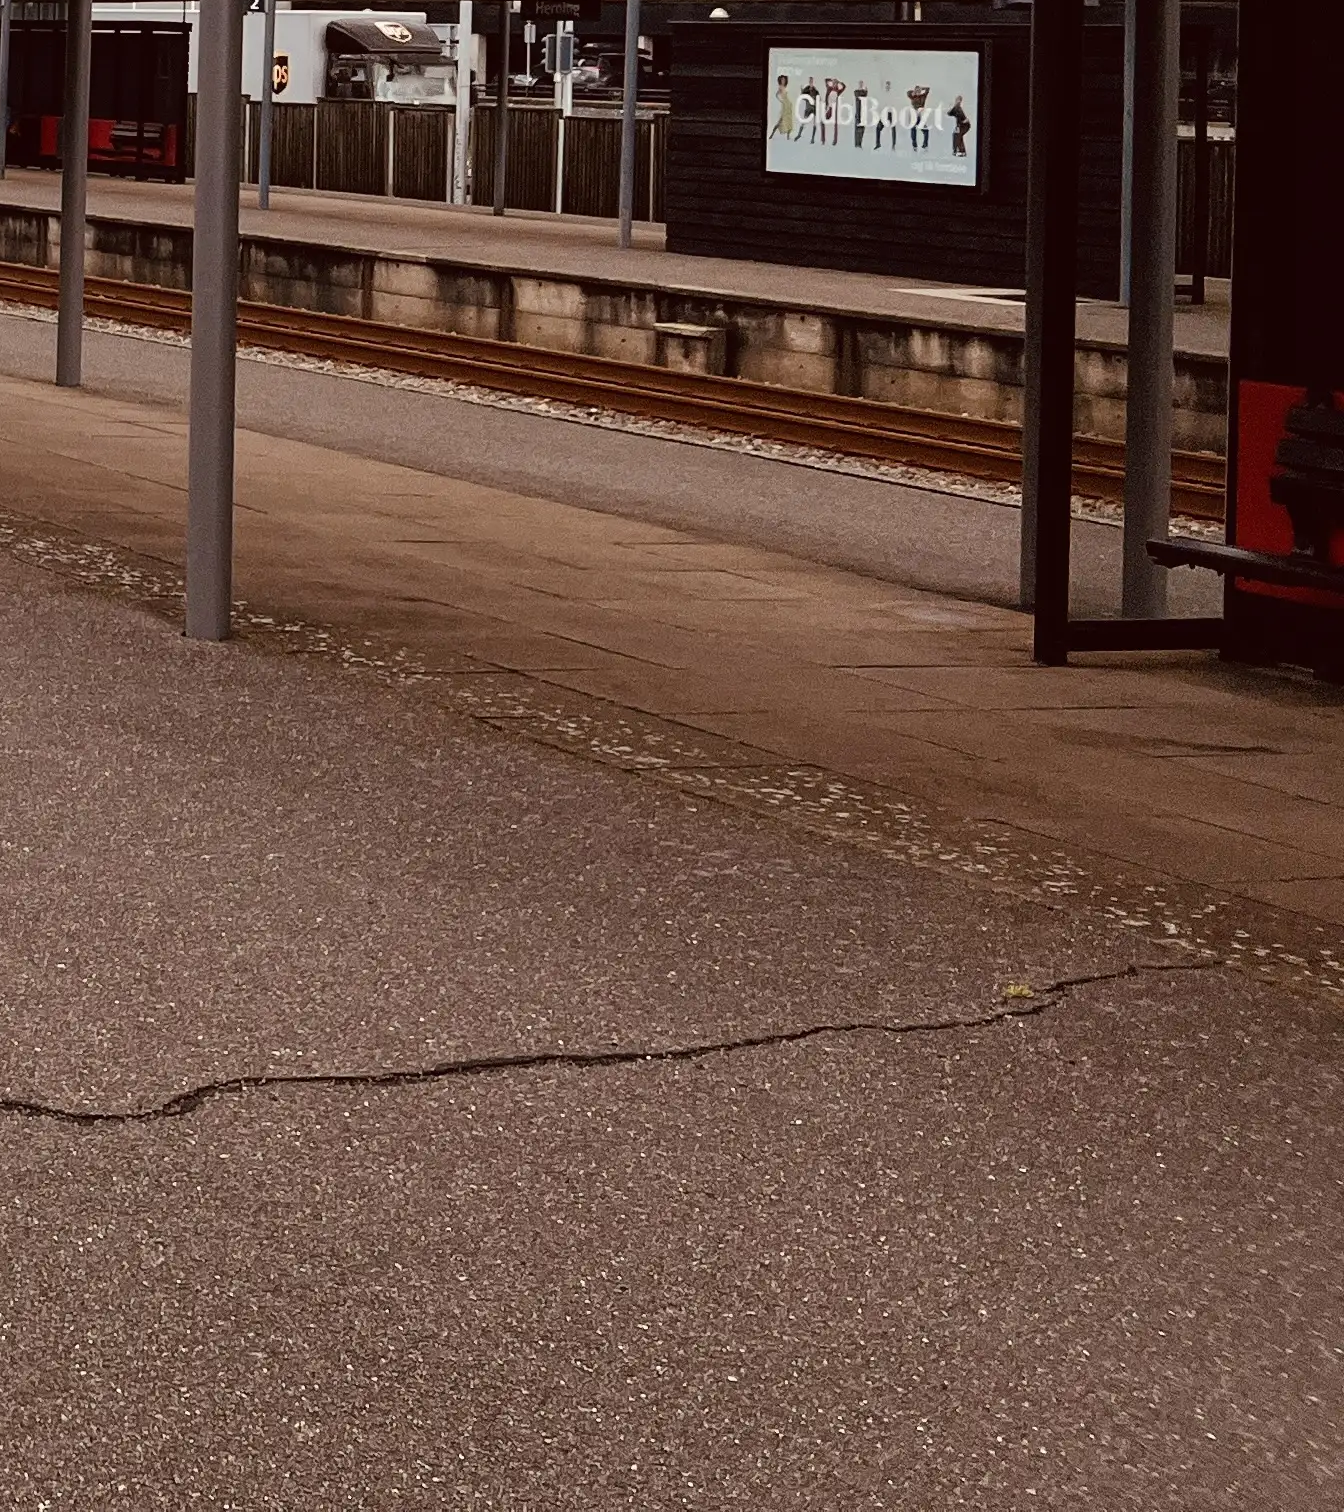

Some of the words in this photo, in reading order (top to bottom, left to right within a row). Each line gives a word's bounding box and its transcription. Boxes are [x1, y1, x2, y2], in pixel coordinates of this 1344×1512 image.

[273, 64, 289, 90] ps
[794, 93, 856, 126] Club
[857, 96, 947, 132] Boozt
